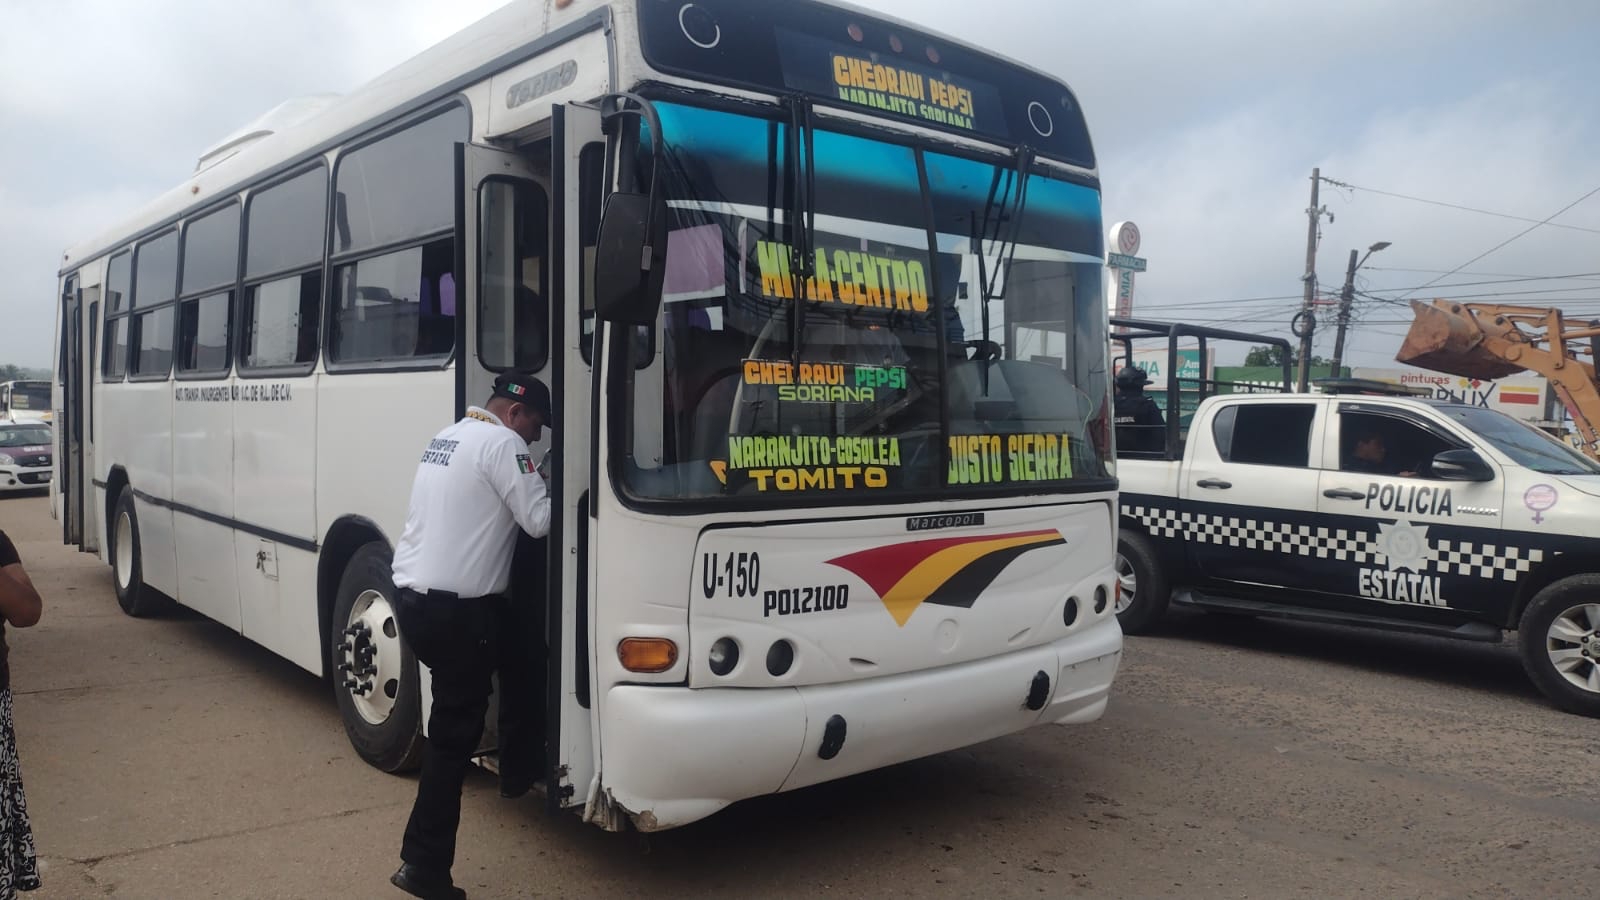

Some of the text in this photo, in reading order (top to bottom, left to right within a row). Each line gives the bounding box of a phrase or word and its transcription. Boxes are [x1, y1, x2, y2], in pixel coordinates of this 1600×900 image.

[833, 55, 975, 118] CHEDRAUI PEPSI
[854, 366, 907, 390] PEPSI
[1400, 373, 1451, 385] pinturas
[250, 385, 258, 401] DE
[271, 384, 279, 402] DE
[778, 386, 875, 402] SORIANA
[947, 433, 1073, 485] JUSTO SIERRA
[749, 467, 888, 492] TOMITO
[1365, 483, 1452, 517] POLICIA
[702, 551, 760, 600] U-150
[1358, 568, 1447, 607] ESTATAL
